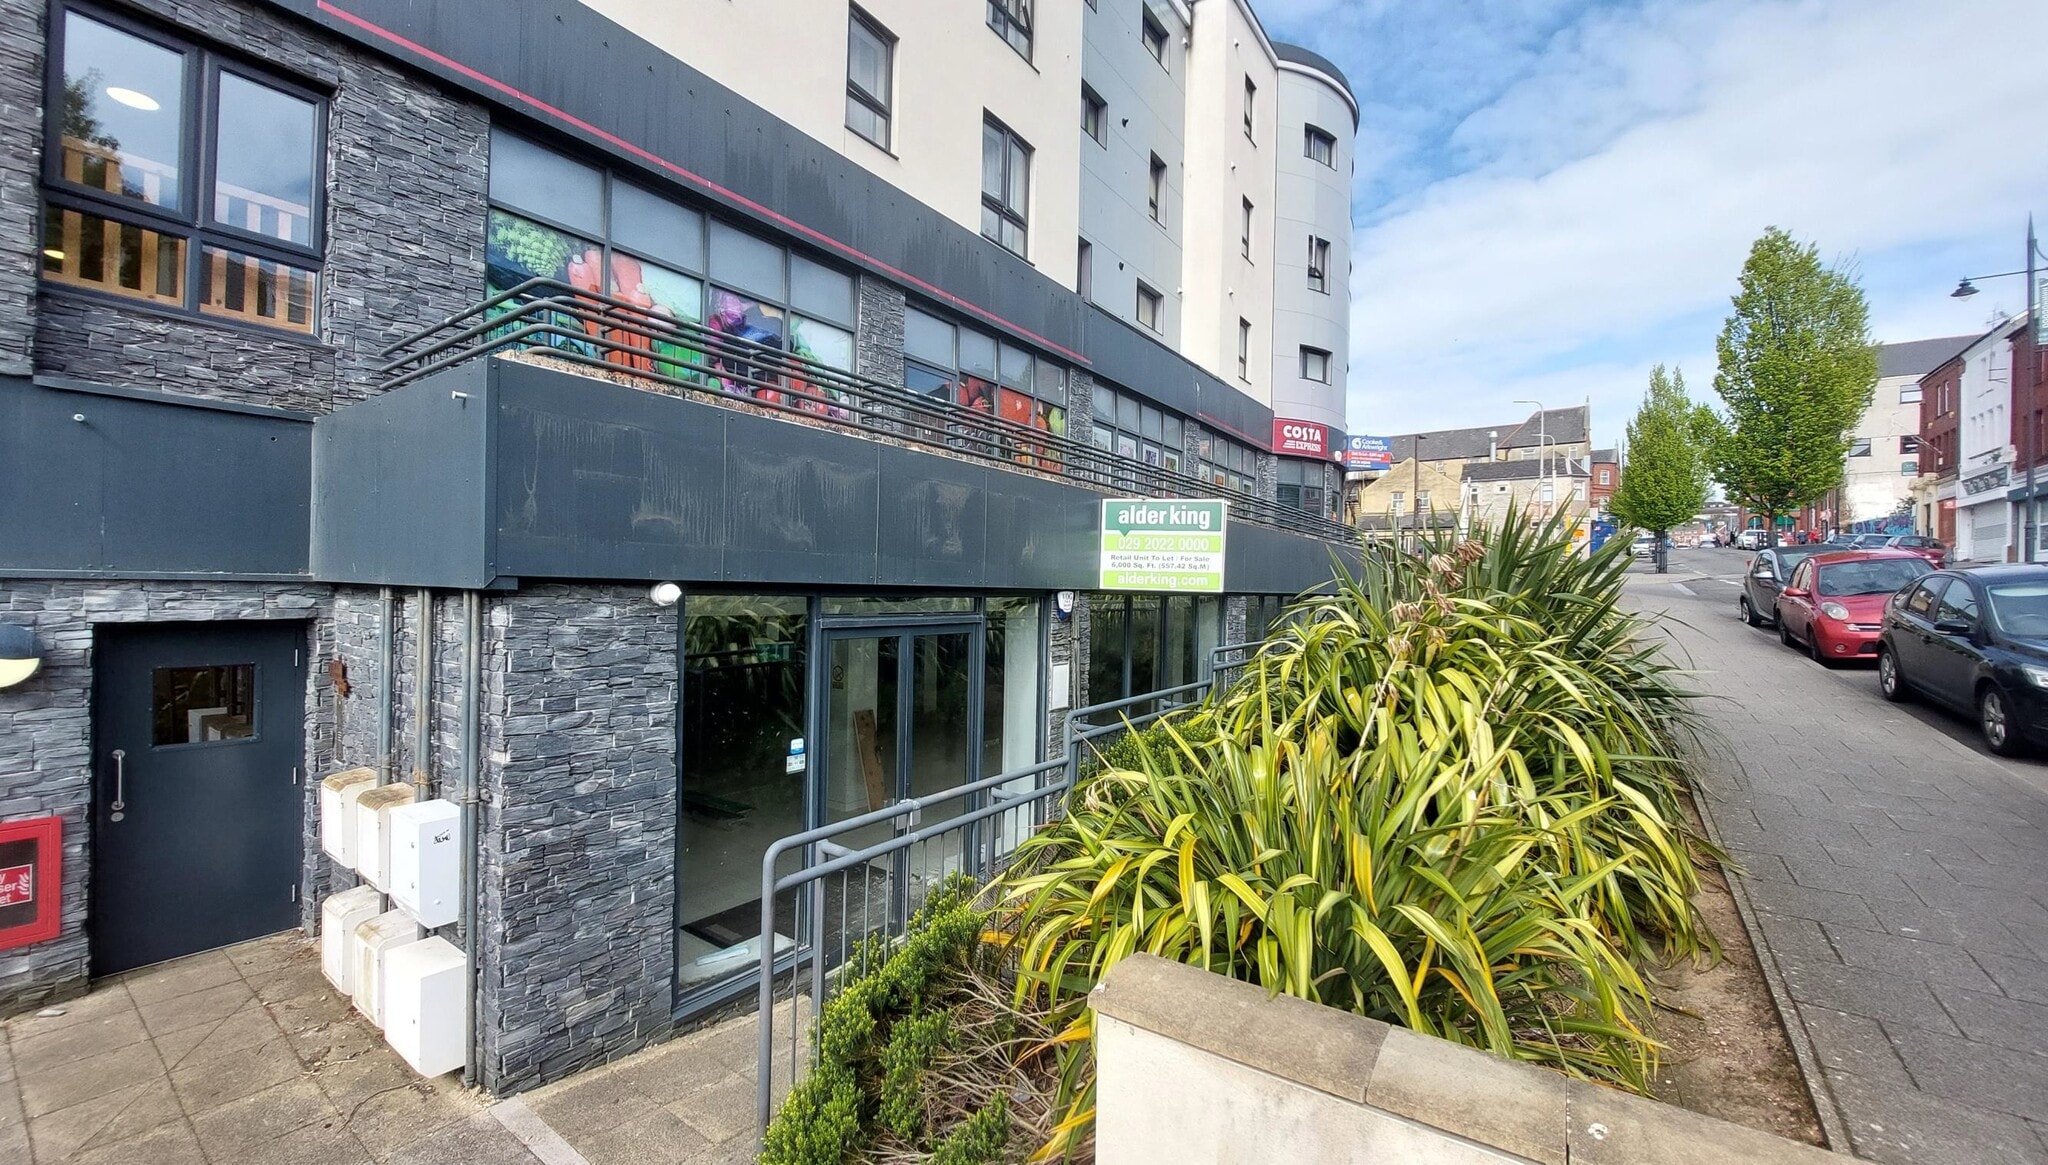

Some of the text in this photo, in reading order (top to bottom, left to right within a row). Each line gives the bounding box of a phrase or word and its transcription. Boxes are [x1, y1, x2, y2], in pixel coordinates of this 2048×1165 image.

[1283, 425, 1321, 442] COSTA
[1296, 441, 1321, 452] EXPRESS
[1118, 505, 1210, 530] alder king
[1119, 537, 1209, 551] 029 2022 0000
[1118, 572, 1208, 588] alderking.com
[0, 882, 17, 893] ser
